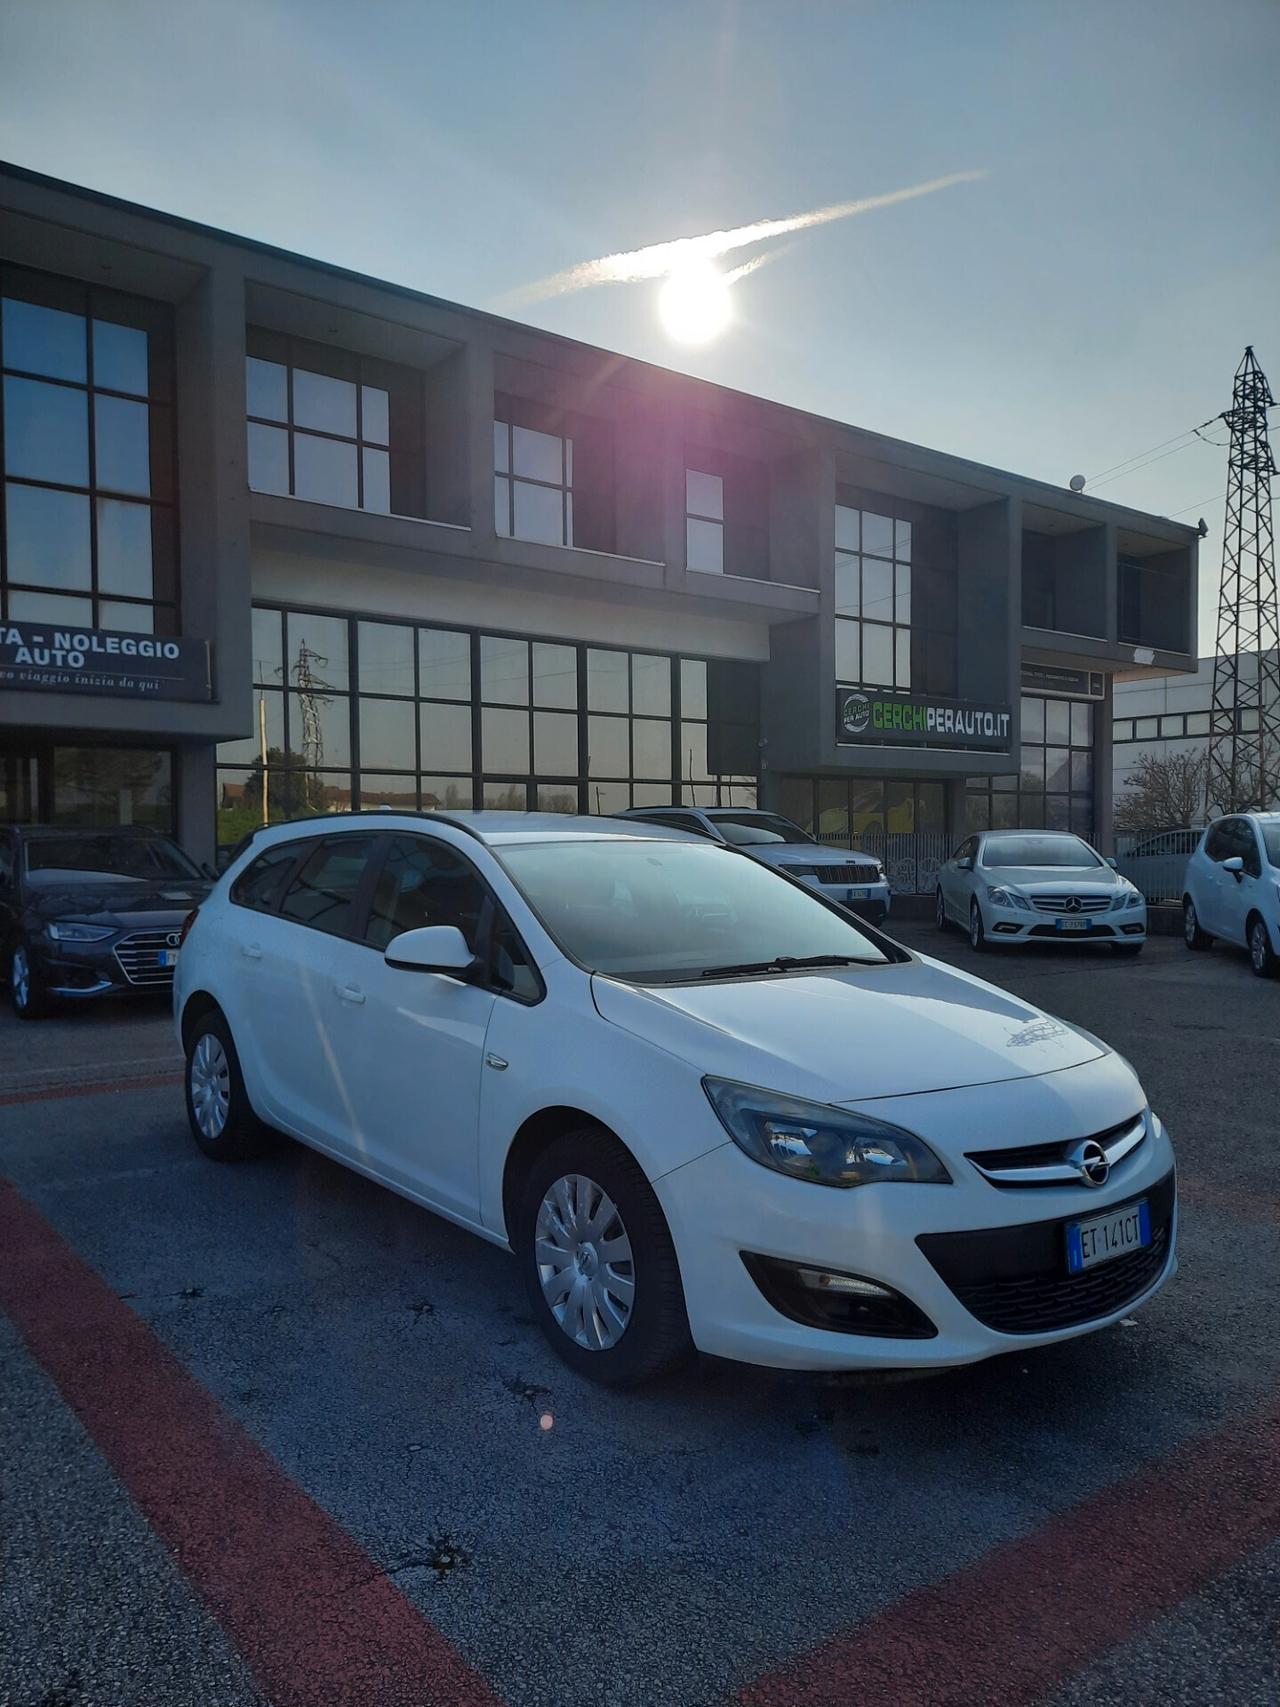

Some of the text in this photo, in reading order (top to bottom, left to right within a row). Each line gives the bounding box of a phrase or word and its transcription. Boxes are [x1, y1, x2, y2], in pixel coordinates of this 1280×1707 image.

[15, 647, 85, 668] AUTO
[54, 632, 180, 659] NOLEGGIO
[19, 669, 70, 685] viaggio
[75, 673, 114, 686] inizia
[119, 676, 134, 688] da
[138, 679, 160, 692] qui
[843, 710, 870, 724] PER AUTO
[872, 701, 1011, 737] CERCHIPERAUTO.IT
[1081, 1214, 1139, 1258] ET 141CT
